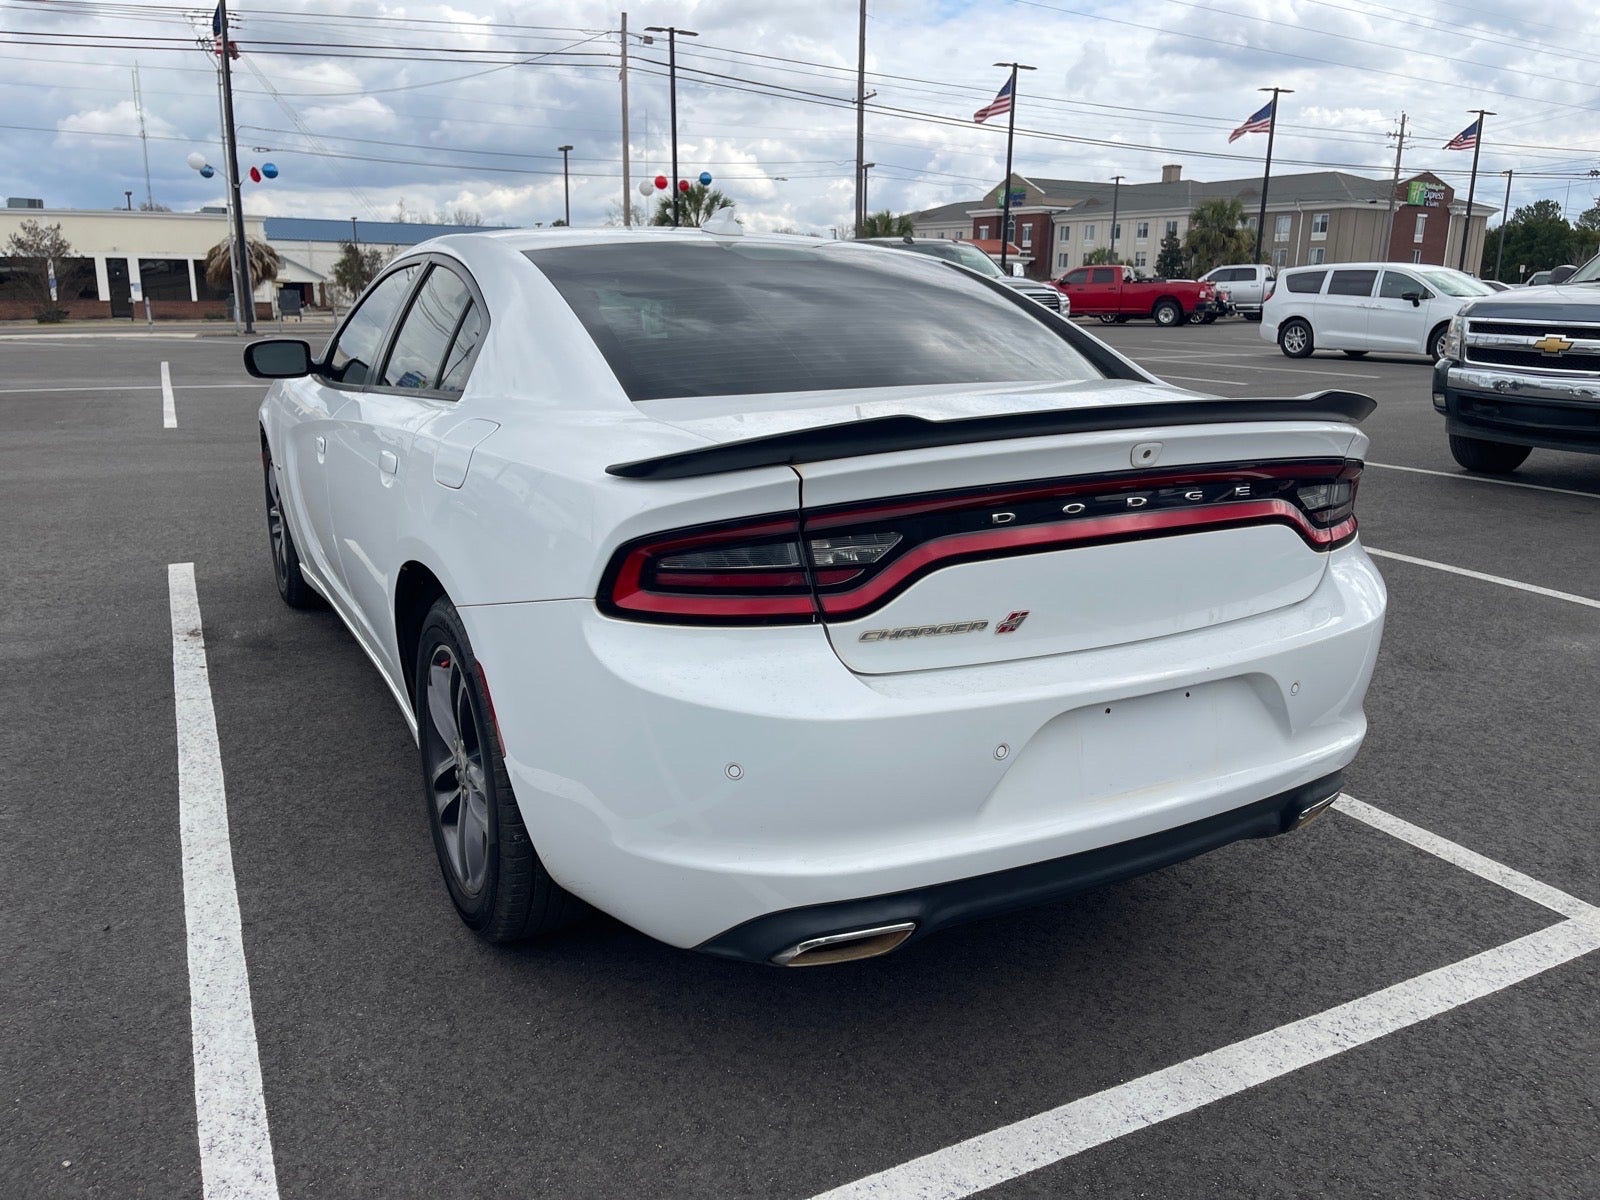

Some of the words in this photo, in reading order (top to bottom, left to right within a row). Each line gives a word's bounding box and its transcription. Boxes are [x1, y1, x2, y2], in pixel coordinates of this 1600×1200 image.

[1424, 189, 1445, 200] Express
[992, 486, 1251, 524] DODGE
[858, 620, 988, 642] CHARGER
